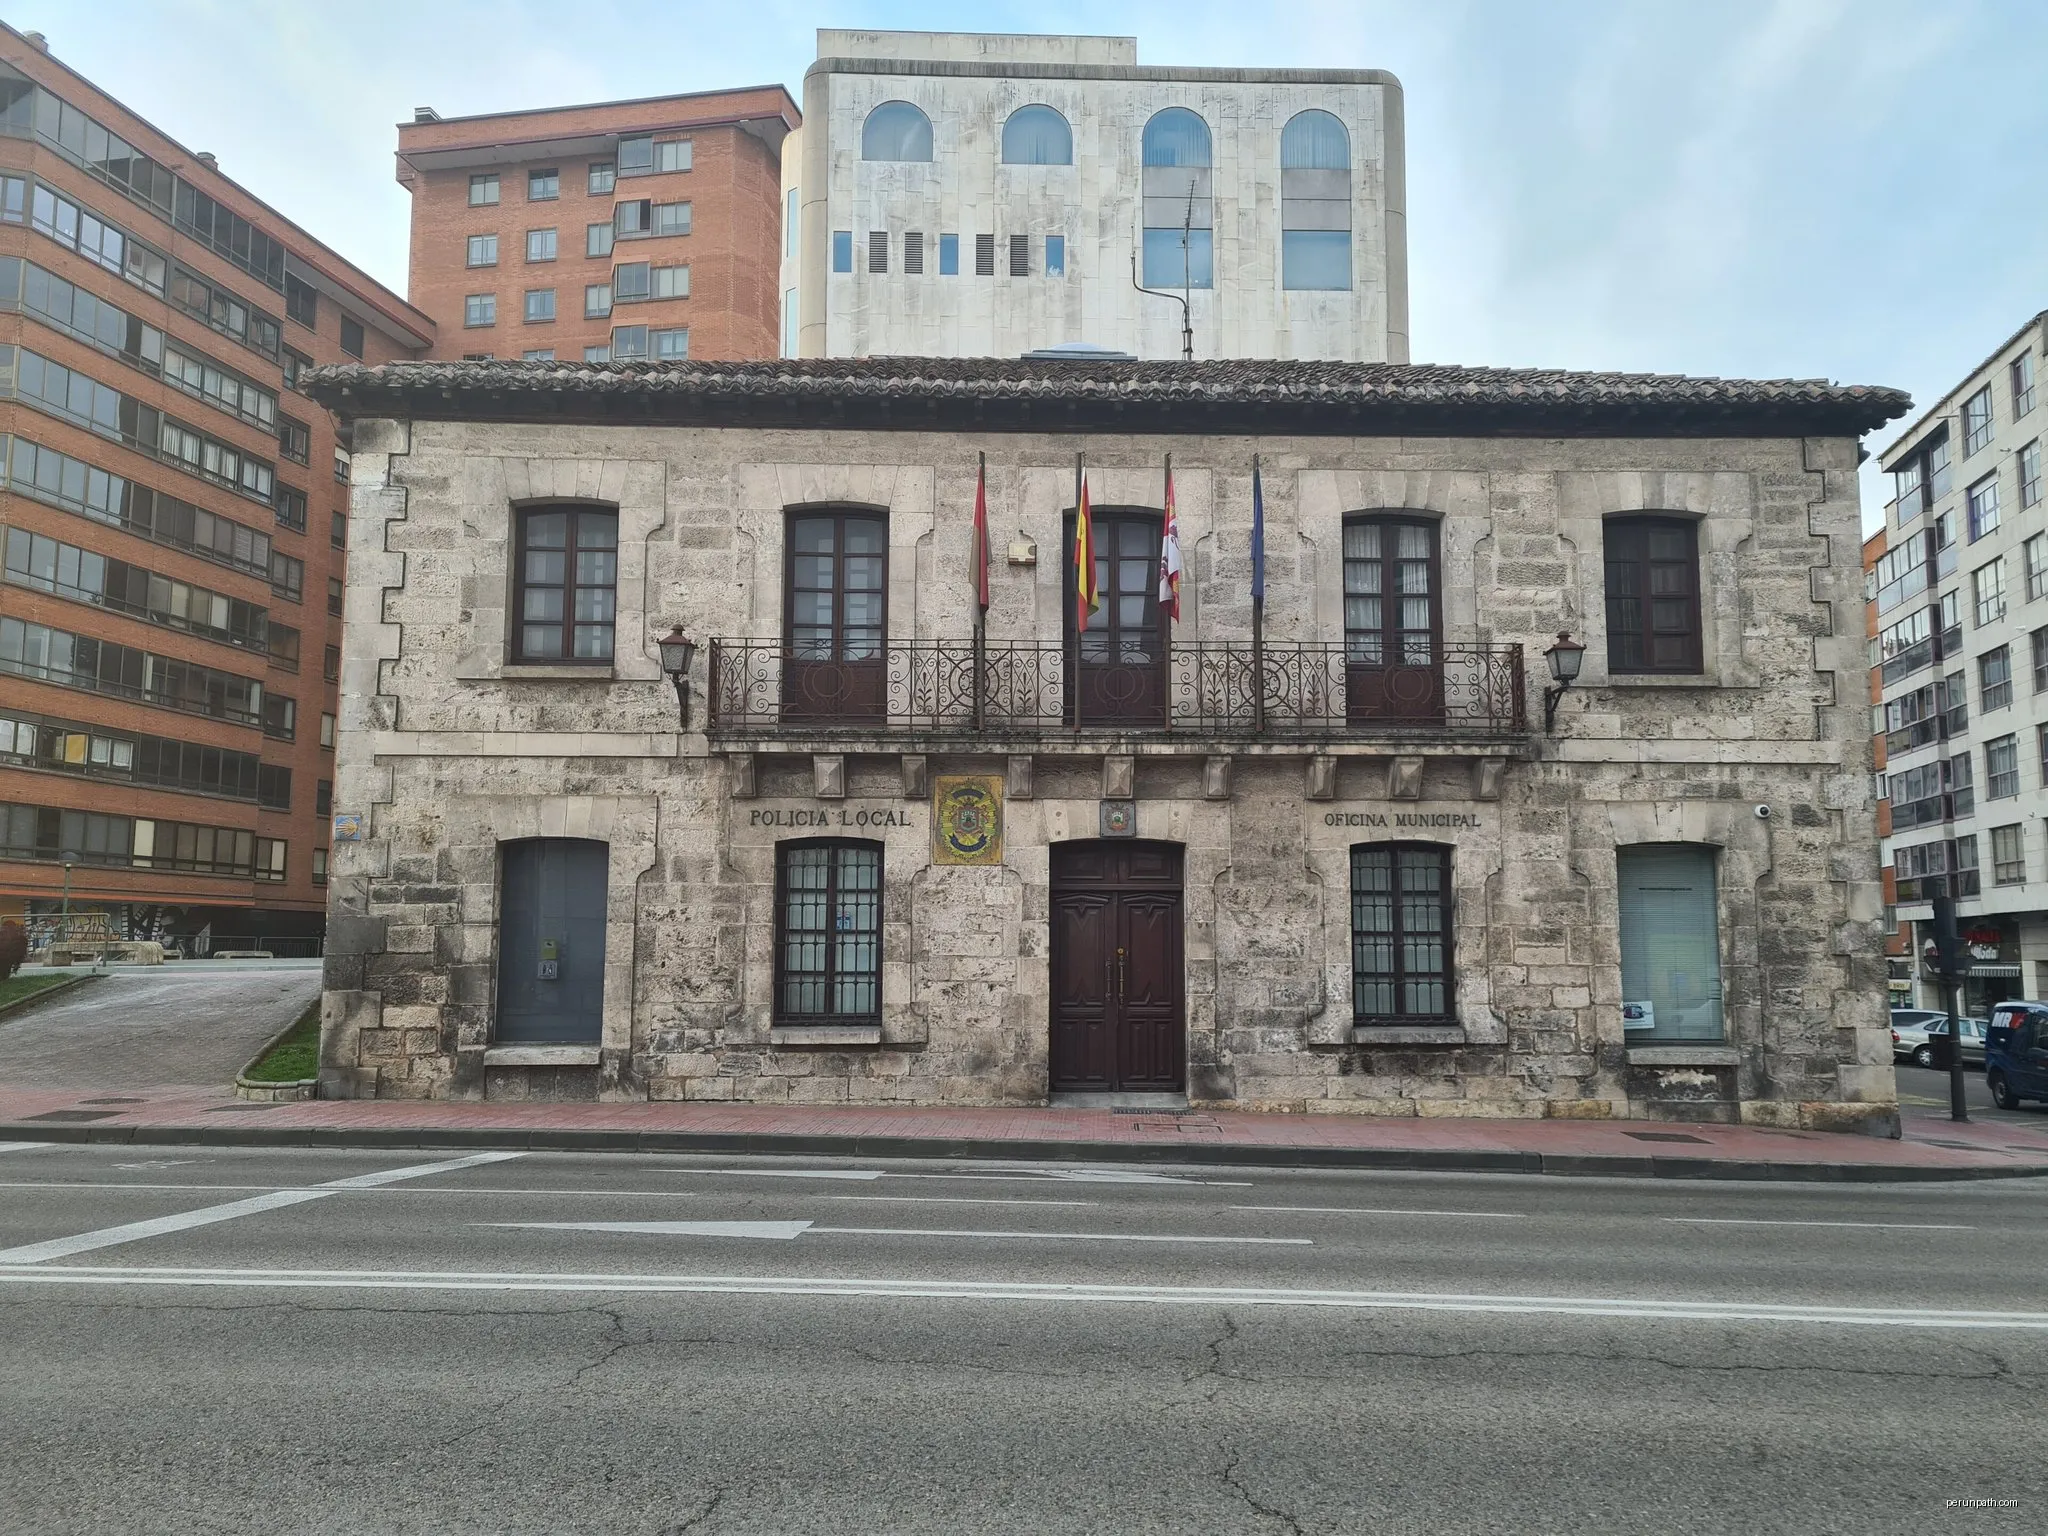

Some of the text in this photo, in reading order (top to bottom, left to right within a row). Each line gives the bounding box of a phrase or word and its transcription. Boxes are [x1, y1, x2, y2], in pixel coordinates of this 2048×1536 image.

[749, 810, 912, 827] POLICIA LOCAL
[1324, 813, 1482, 827] OFICINA MUNICIPAL
